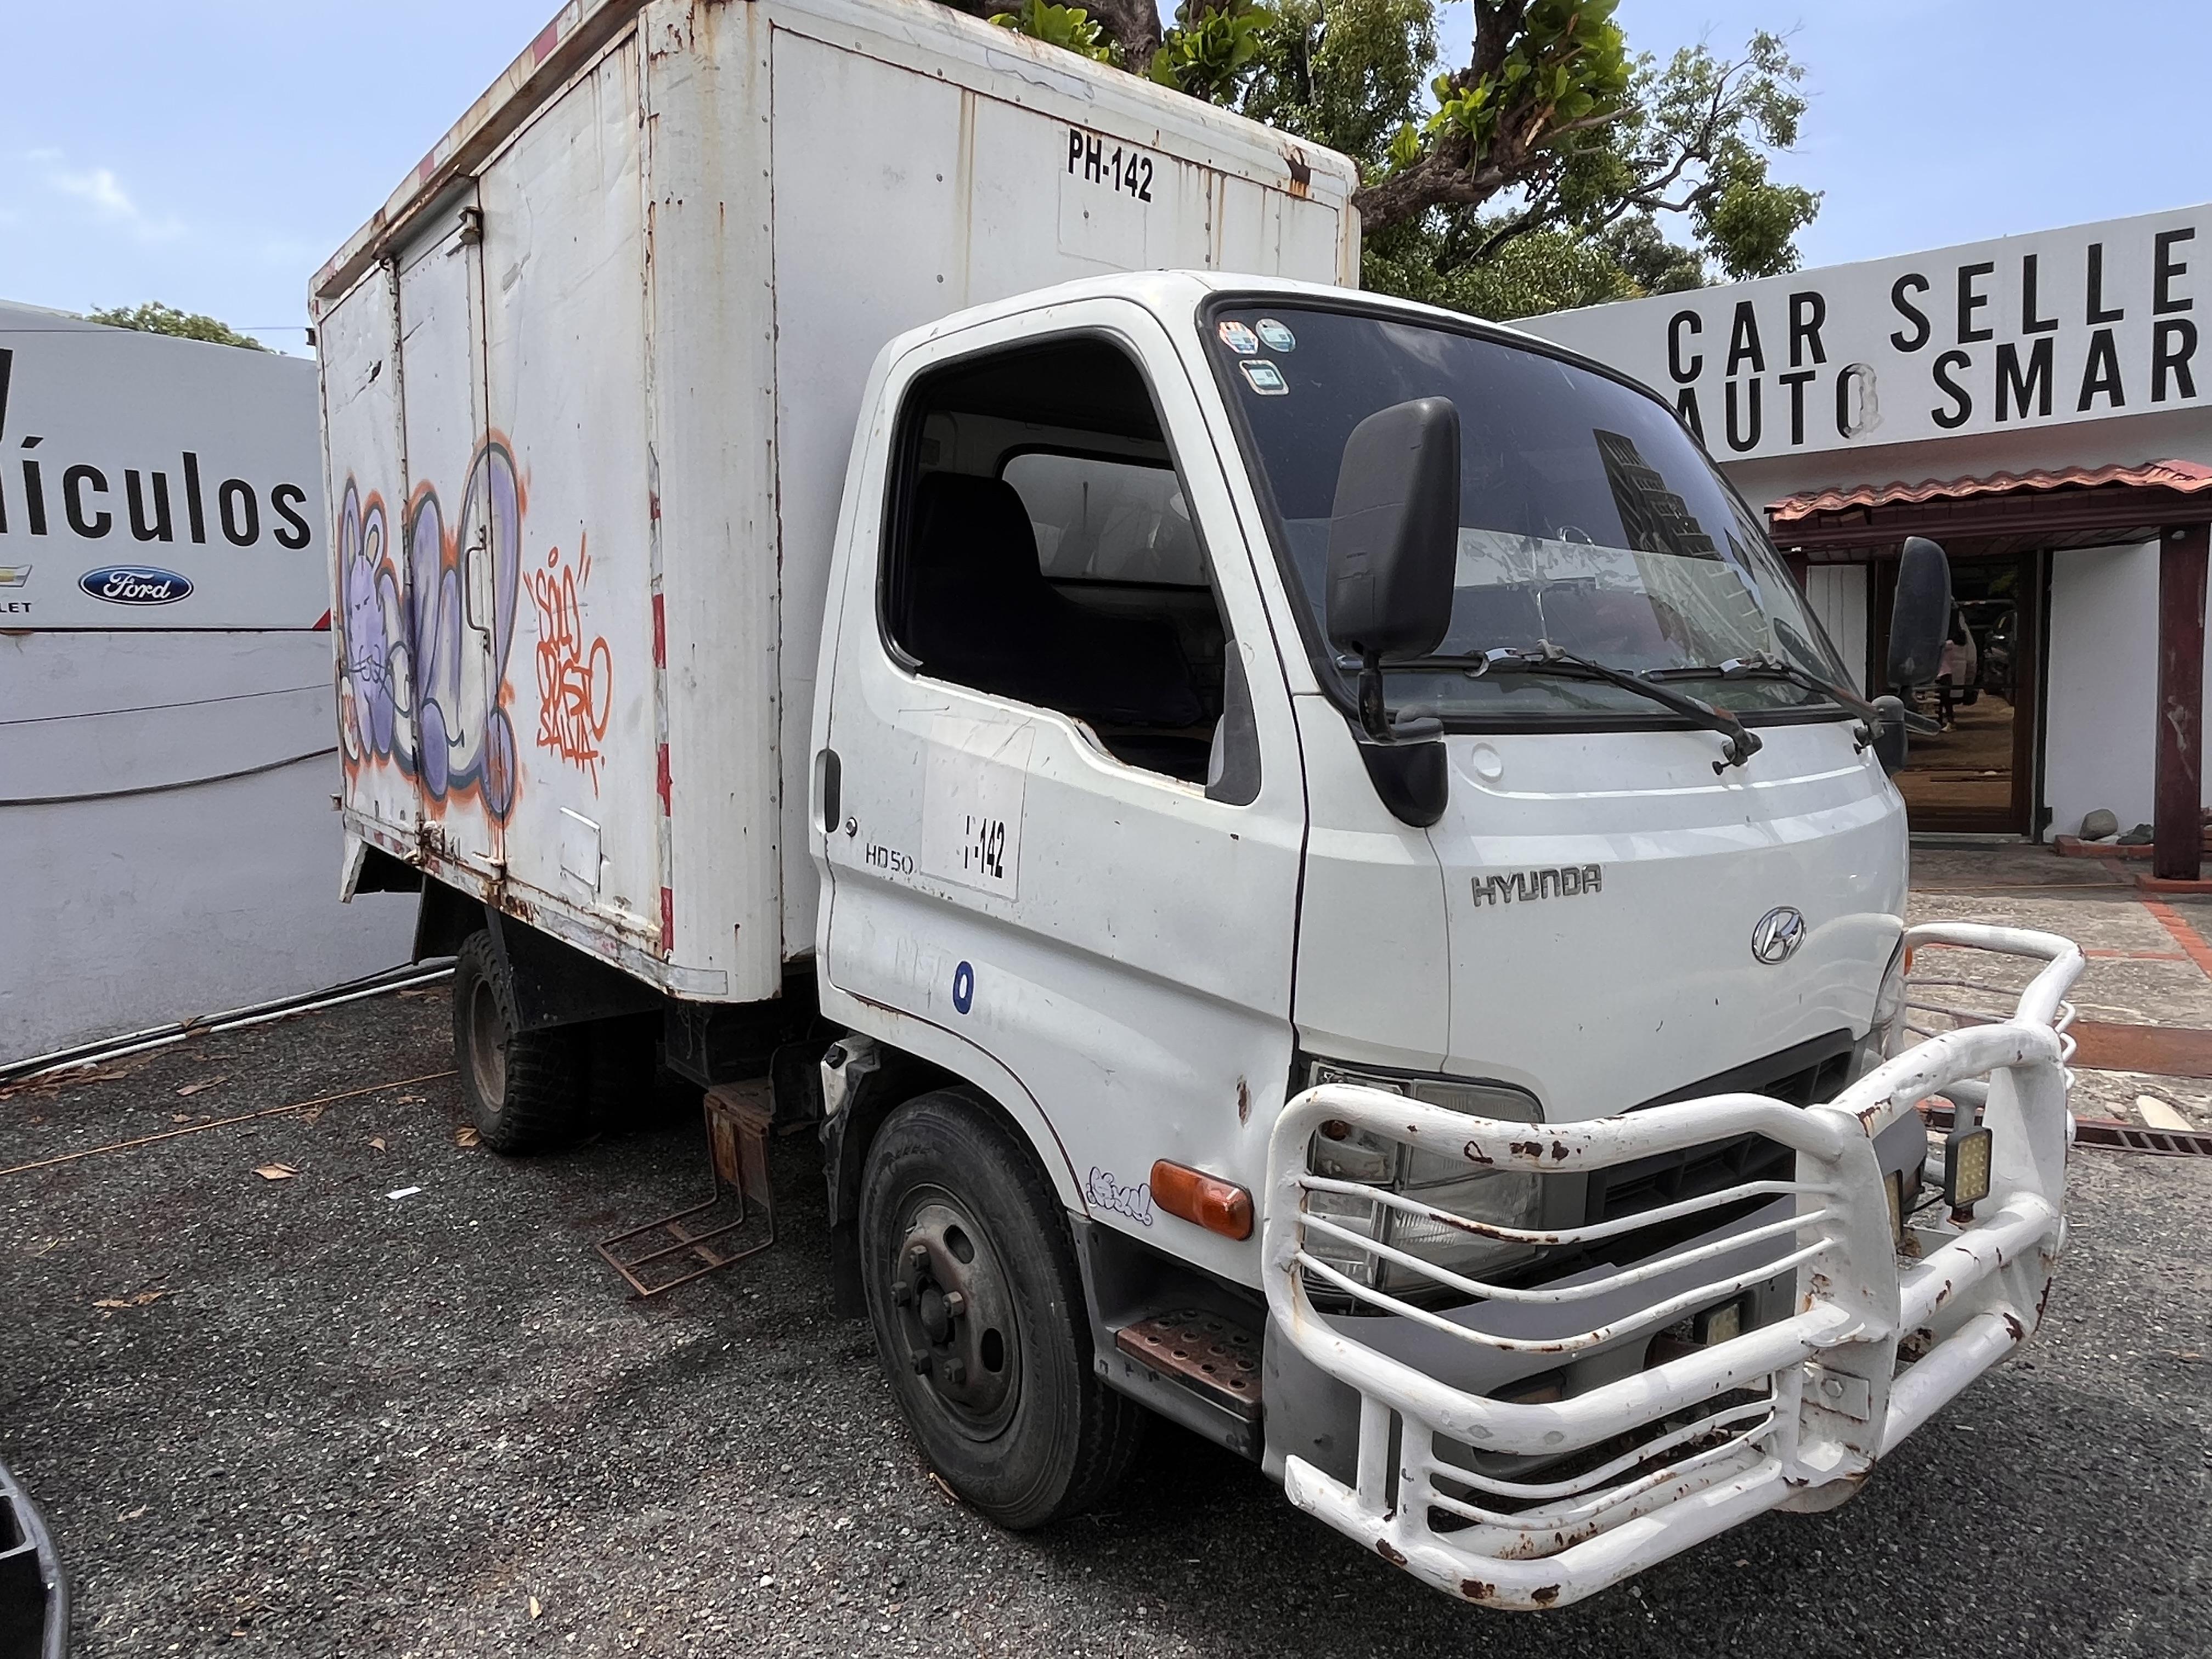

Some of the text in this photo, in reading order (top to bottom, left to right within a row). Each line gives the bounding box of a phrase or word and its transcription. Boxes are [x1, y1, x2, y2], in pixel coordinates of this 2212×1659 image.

[1068, 128, 1153, 202] PH-142
[1668, 227, 2195, 383] CAR SELLE
[1931, 318, 2197, 430] SMAR
[103, 569, 171, 600] Ford
[866, 843, 913, 875] HD50
